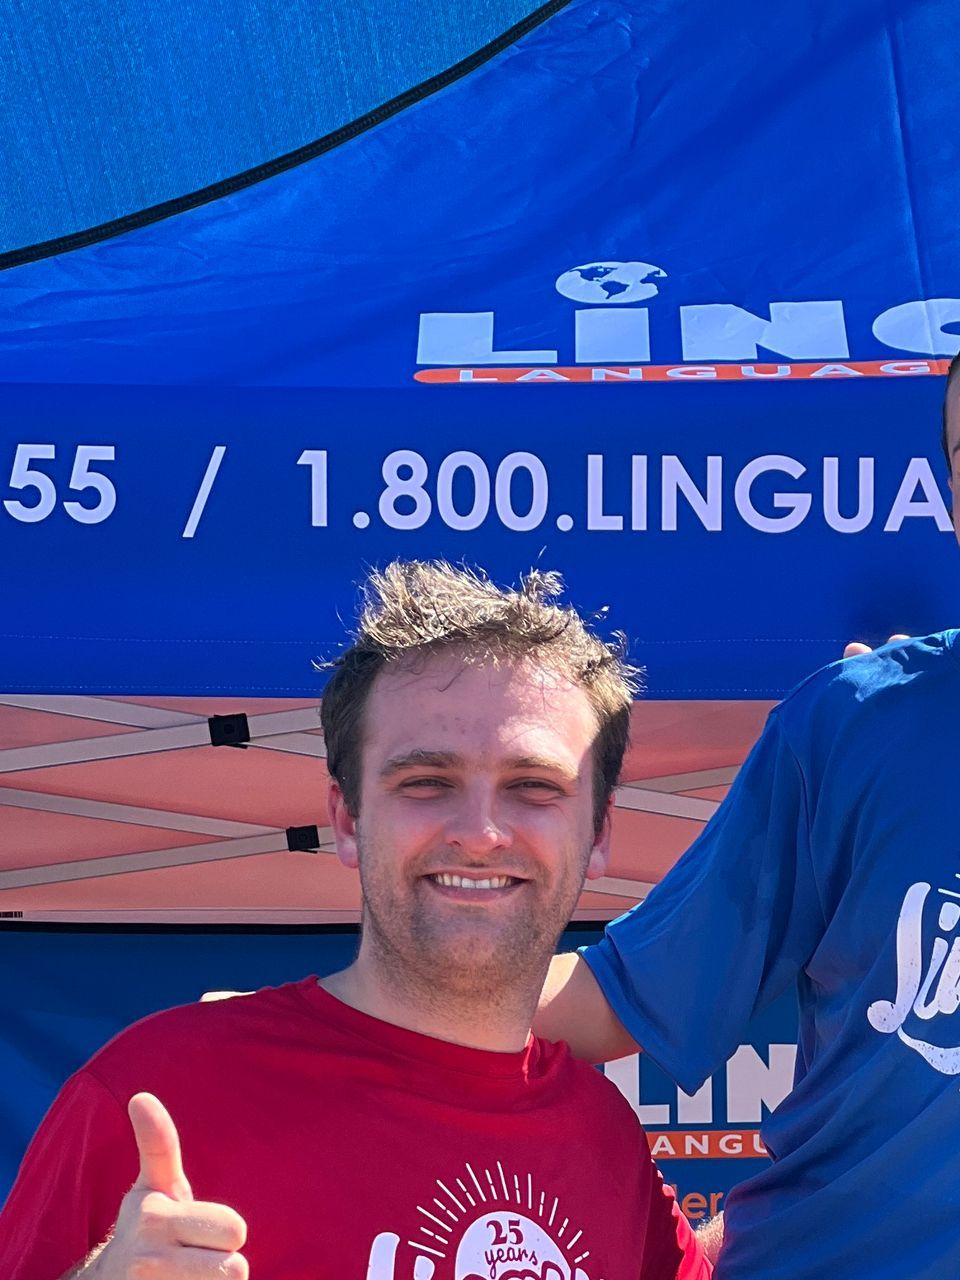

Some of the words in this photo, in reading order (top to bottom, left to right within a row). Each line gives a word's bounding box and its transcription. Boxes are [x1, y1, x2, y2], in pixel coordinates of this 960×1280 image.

[3, 443, 117, 525] 55
[297, 449, 954, 534] 1.800.LINGUA
[487, 1220, 523, 1245] 25
[485, 1247, 538, 1279] years
